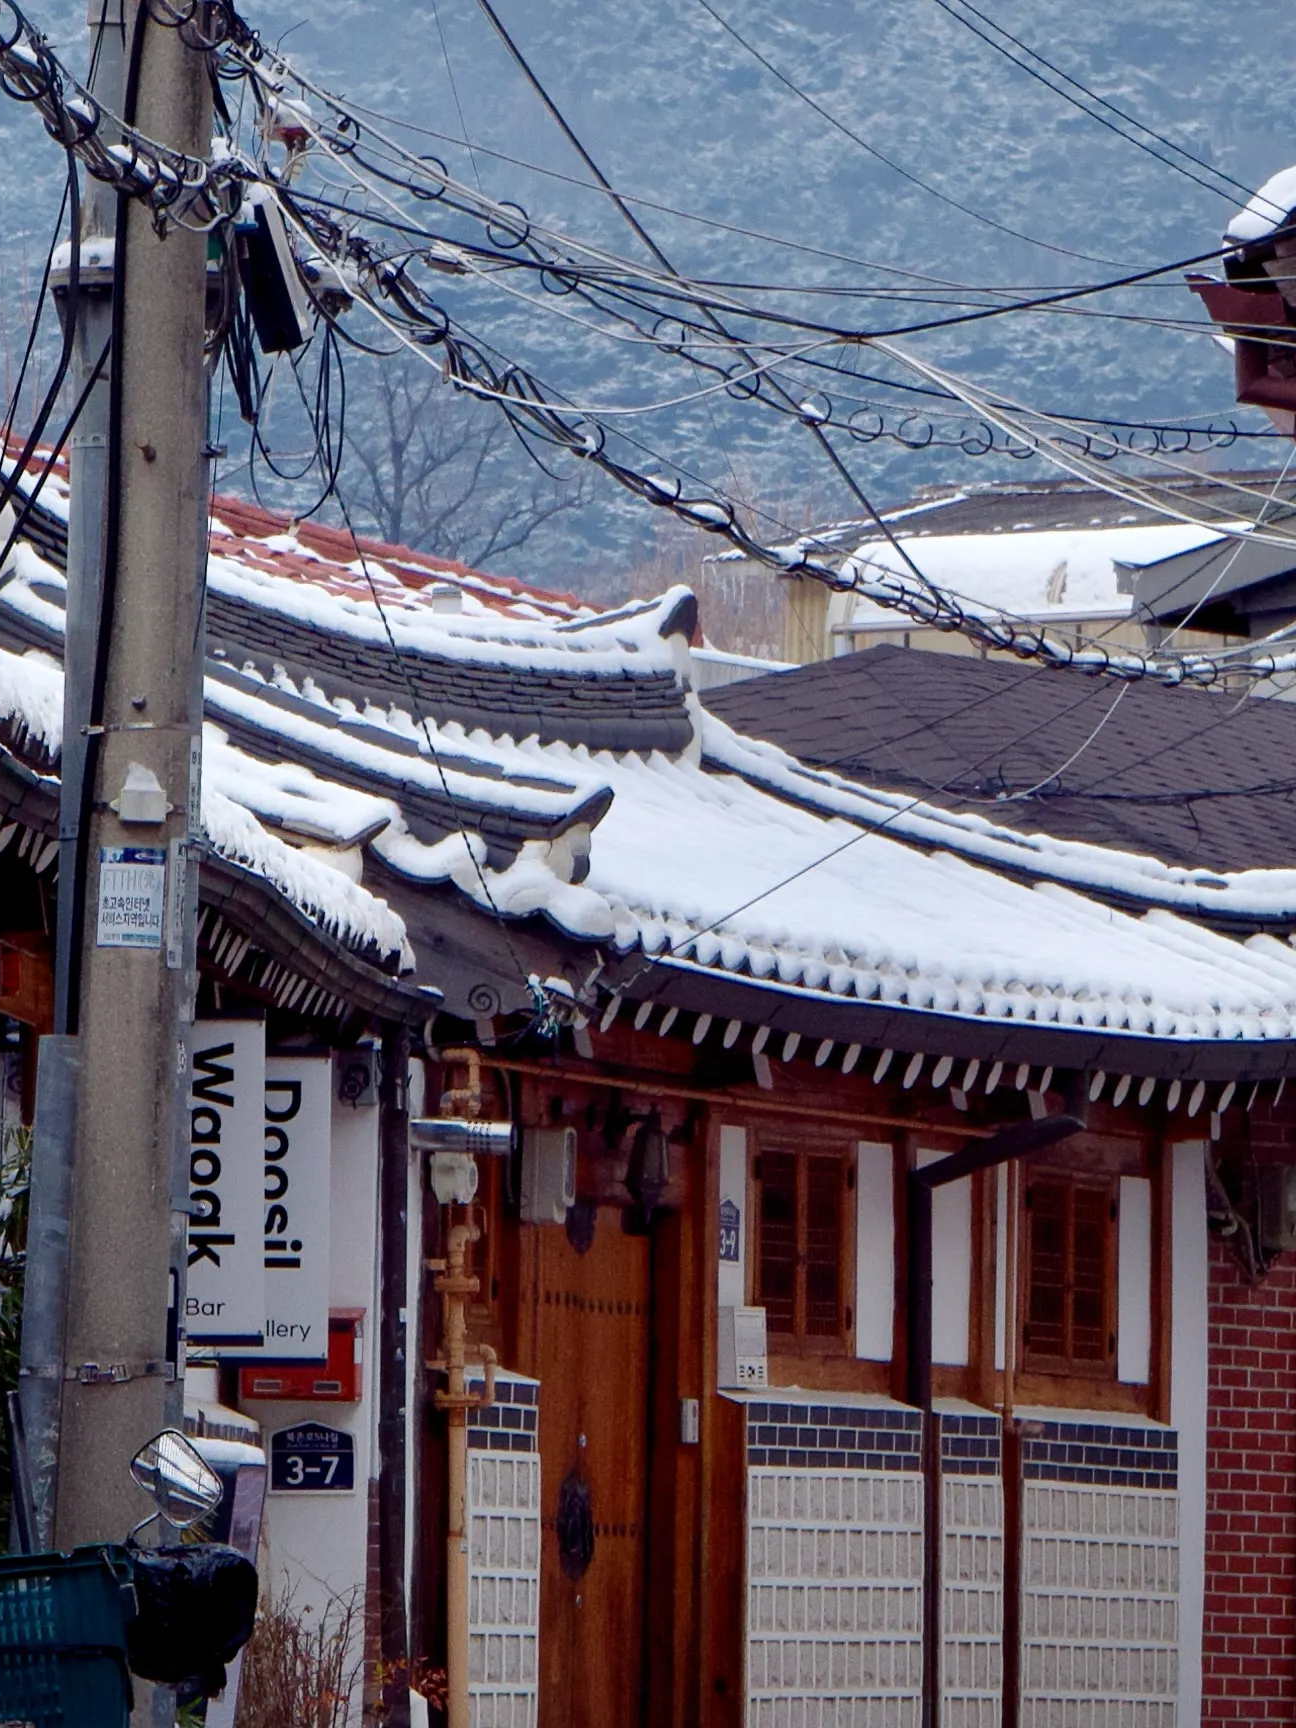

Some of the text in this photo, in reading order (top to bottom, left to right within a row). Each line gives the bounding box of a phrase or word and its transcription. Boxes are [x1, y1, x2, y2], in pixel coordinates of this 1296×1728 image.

[264, 1080, 302, 1268] Doosil
[185, 1298, 226, 1316] Bar
[266, 1320, 311, 1342] llery
[286, 1456, 340, 1484] 3-7
